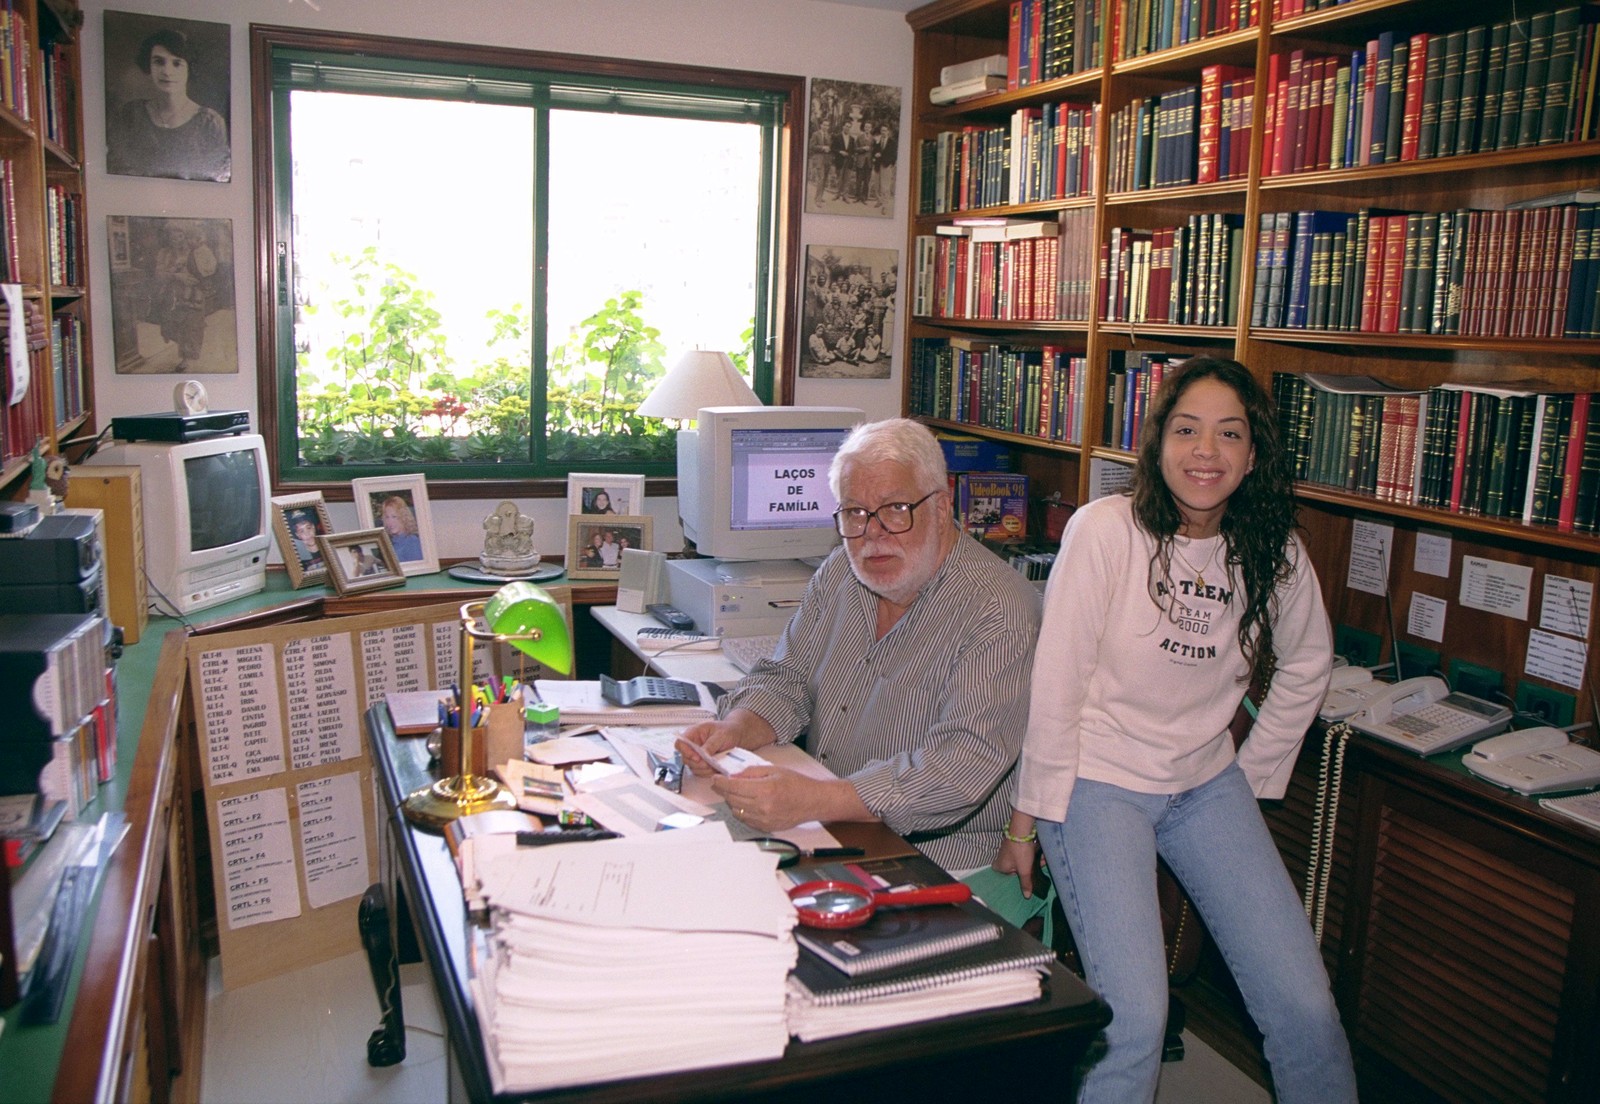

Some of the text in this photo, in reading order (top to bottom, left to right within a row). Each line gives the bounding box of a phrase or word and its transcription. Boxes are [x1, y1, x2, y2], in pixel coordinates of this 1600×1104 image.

[774, 469, 815, 481] LAÇOS
[787, 486, 804, 495] DE
[969, 483, 1024, 497] VideoBook 98
[769, 500, 819, 512] FAMÍLIA
[1179, 607, 1211, 620] TEAM
[1179, 620, 1208, 635] 2000
[237, 647, 263, 655] HELENA
[1159, 638, 1216, 658] ACTION
[237, 655, 262, 663] MIGUEL
[314, 659, 336, 667] SIMONE
[238, 663, 261, 671] PEDRO
[238, 672, 263, 680] CAMILA
[314, 668, 332, 676] ZILDA
[317, 699, 336, 707] MARIA
[241, 704, 266, 713] DANILO
[318, 716, 340, 724] ESTELA
[243, 721, 266, 730] INGRID
[319, 732, 337, 740] NILDA
[244, 737, 268, 747] CAPITU
[320, 748, 340, 756] PAULO
[246, 755, 280, 765] PASCHOAL
[299, 782, 316, 790] CRTL
[221, 798, 242, 807] CRTL
[301, 800, 318, 808] CRTL
[224, 818, 243, 827] CRTL
[225, 838, 245, 847] CRTL
[227, 857, 247, 866] CRTL
[230, 882, 249, 891] CRTL
[232, 901, 251, 911] CRTL
